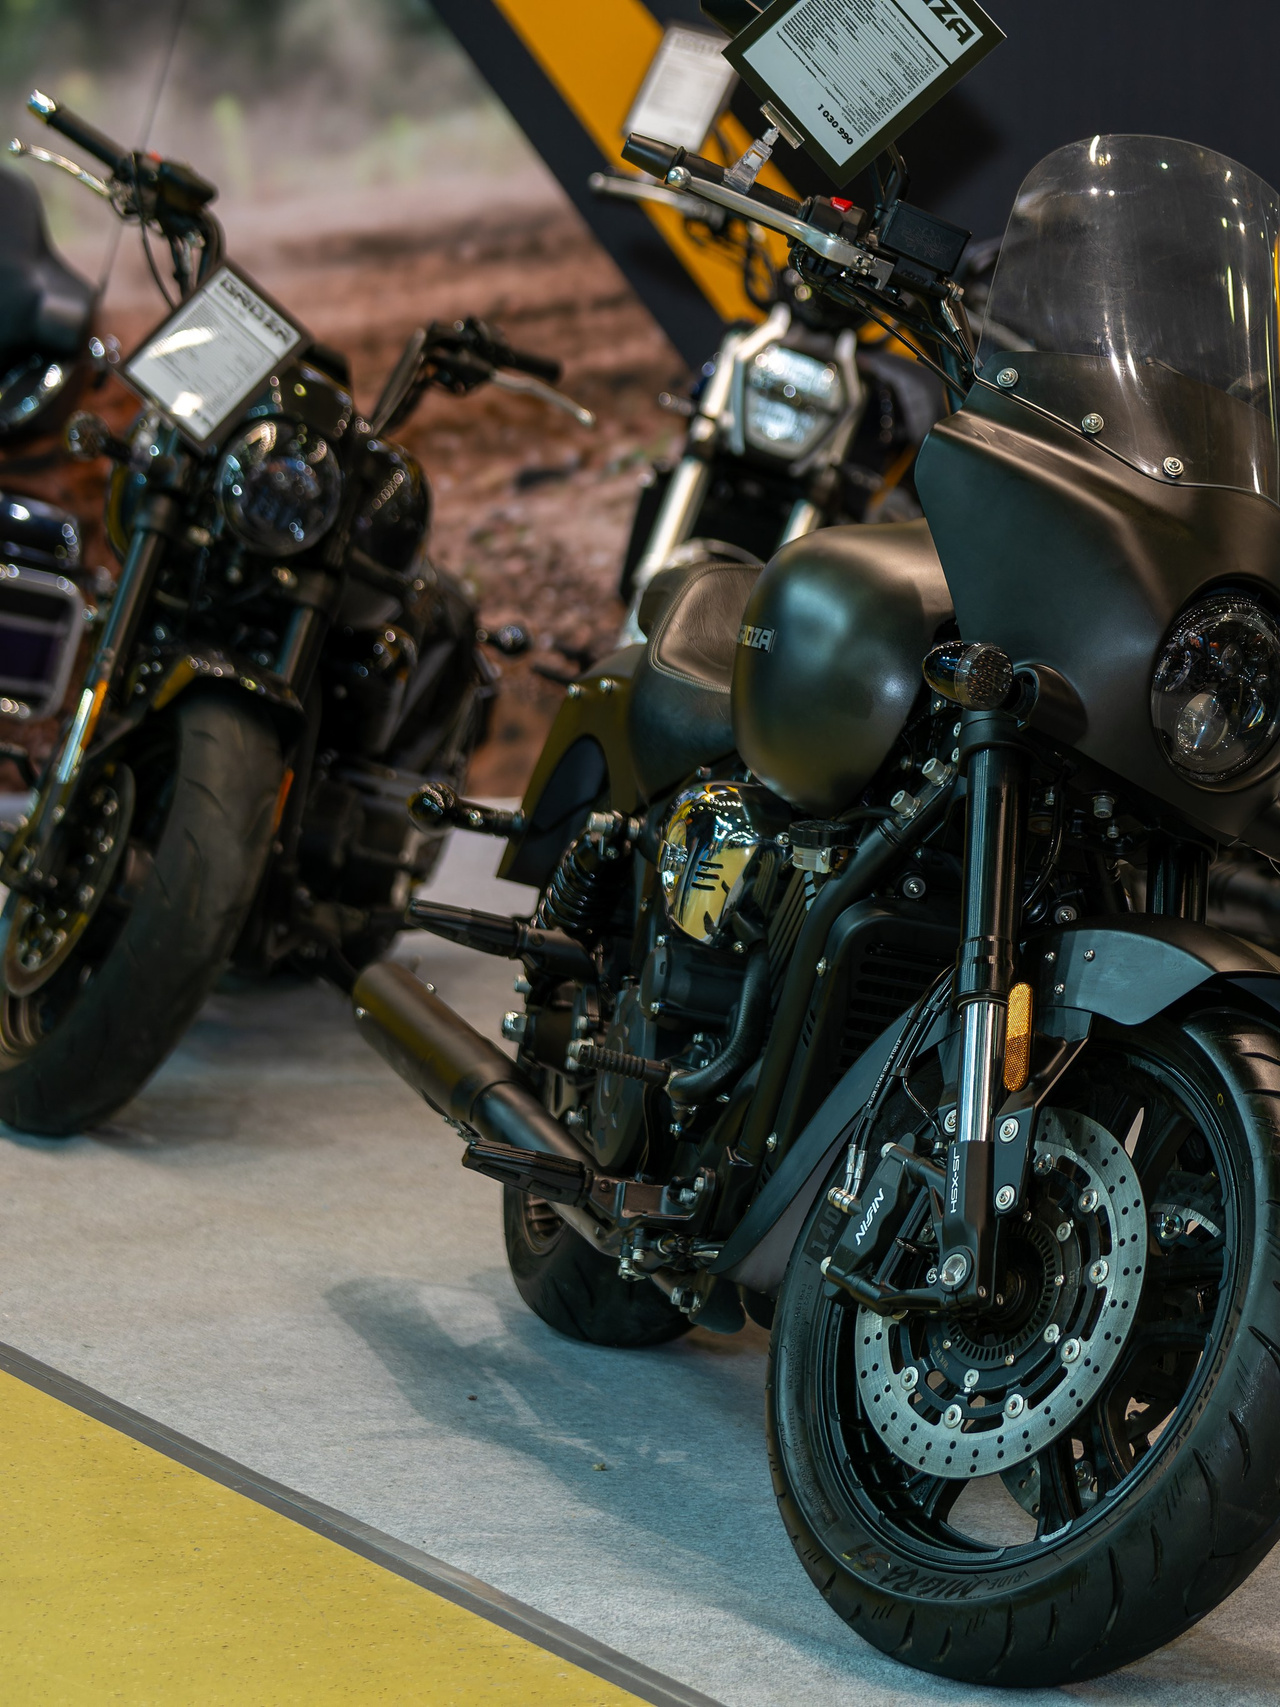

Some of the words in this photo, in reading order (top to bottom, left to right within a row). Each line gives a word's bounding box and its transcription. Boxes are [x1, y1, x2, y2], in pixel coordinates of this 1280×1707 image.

[922, 0, 976, 46] ZA
[817, 103, 825, 111] 1
[822, 110, 839, 128] 030
[837, 127, 854, 145] 990
